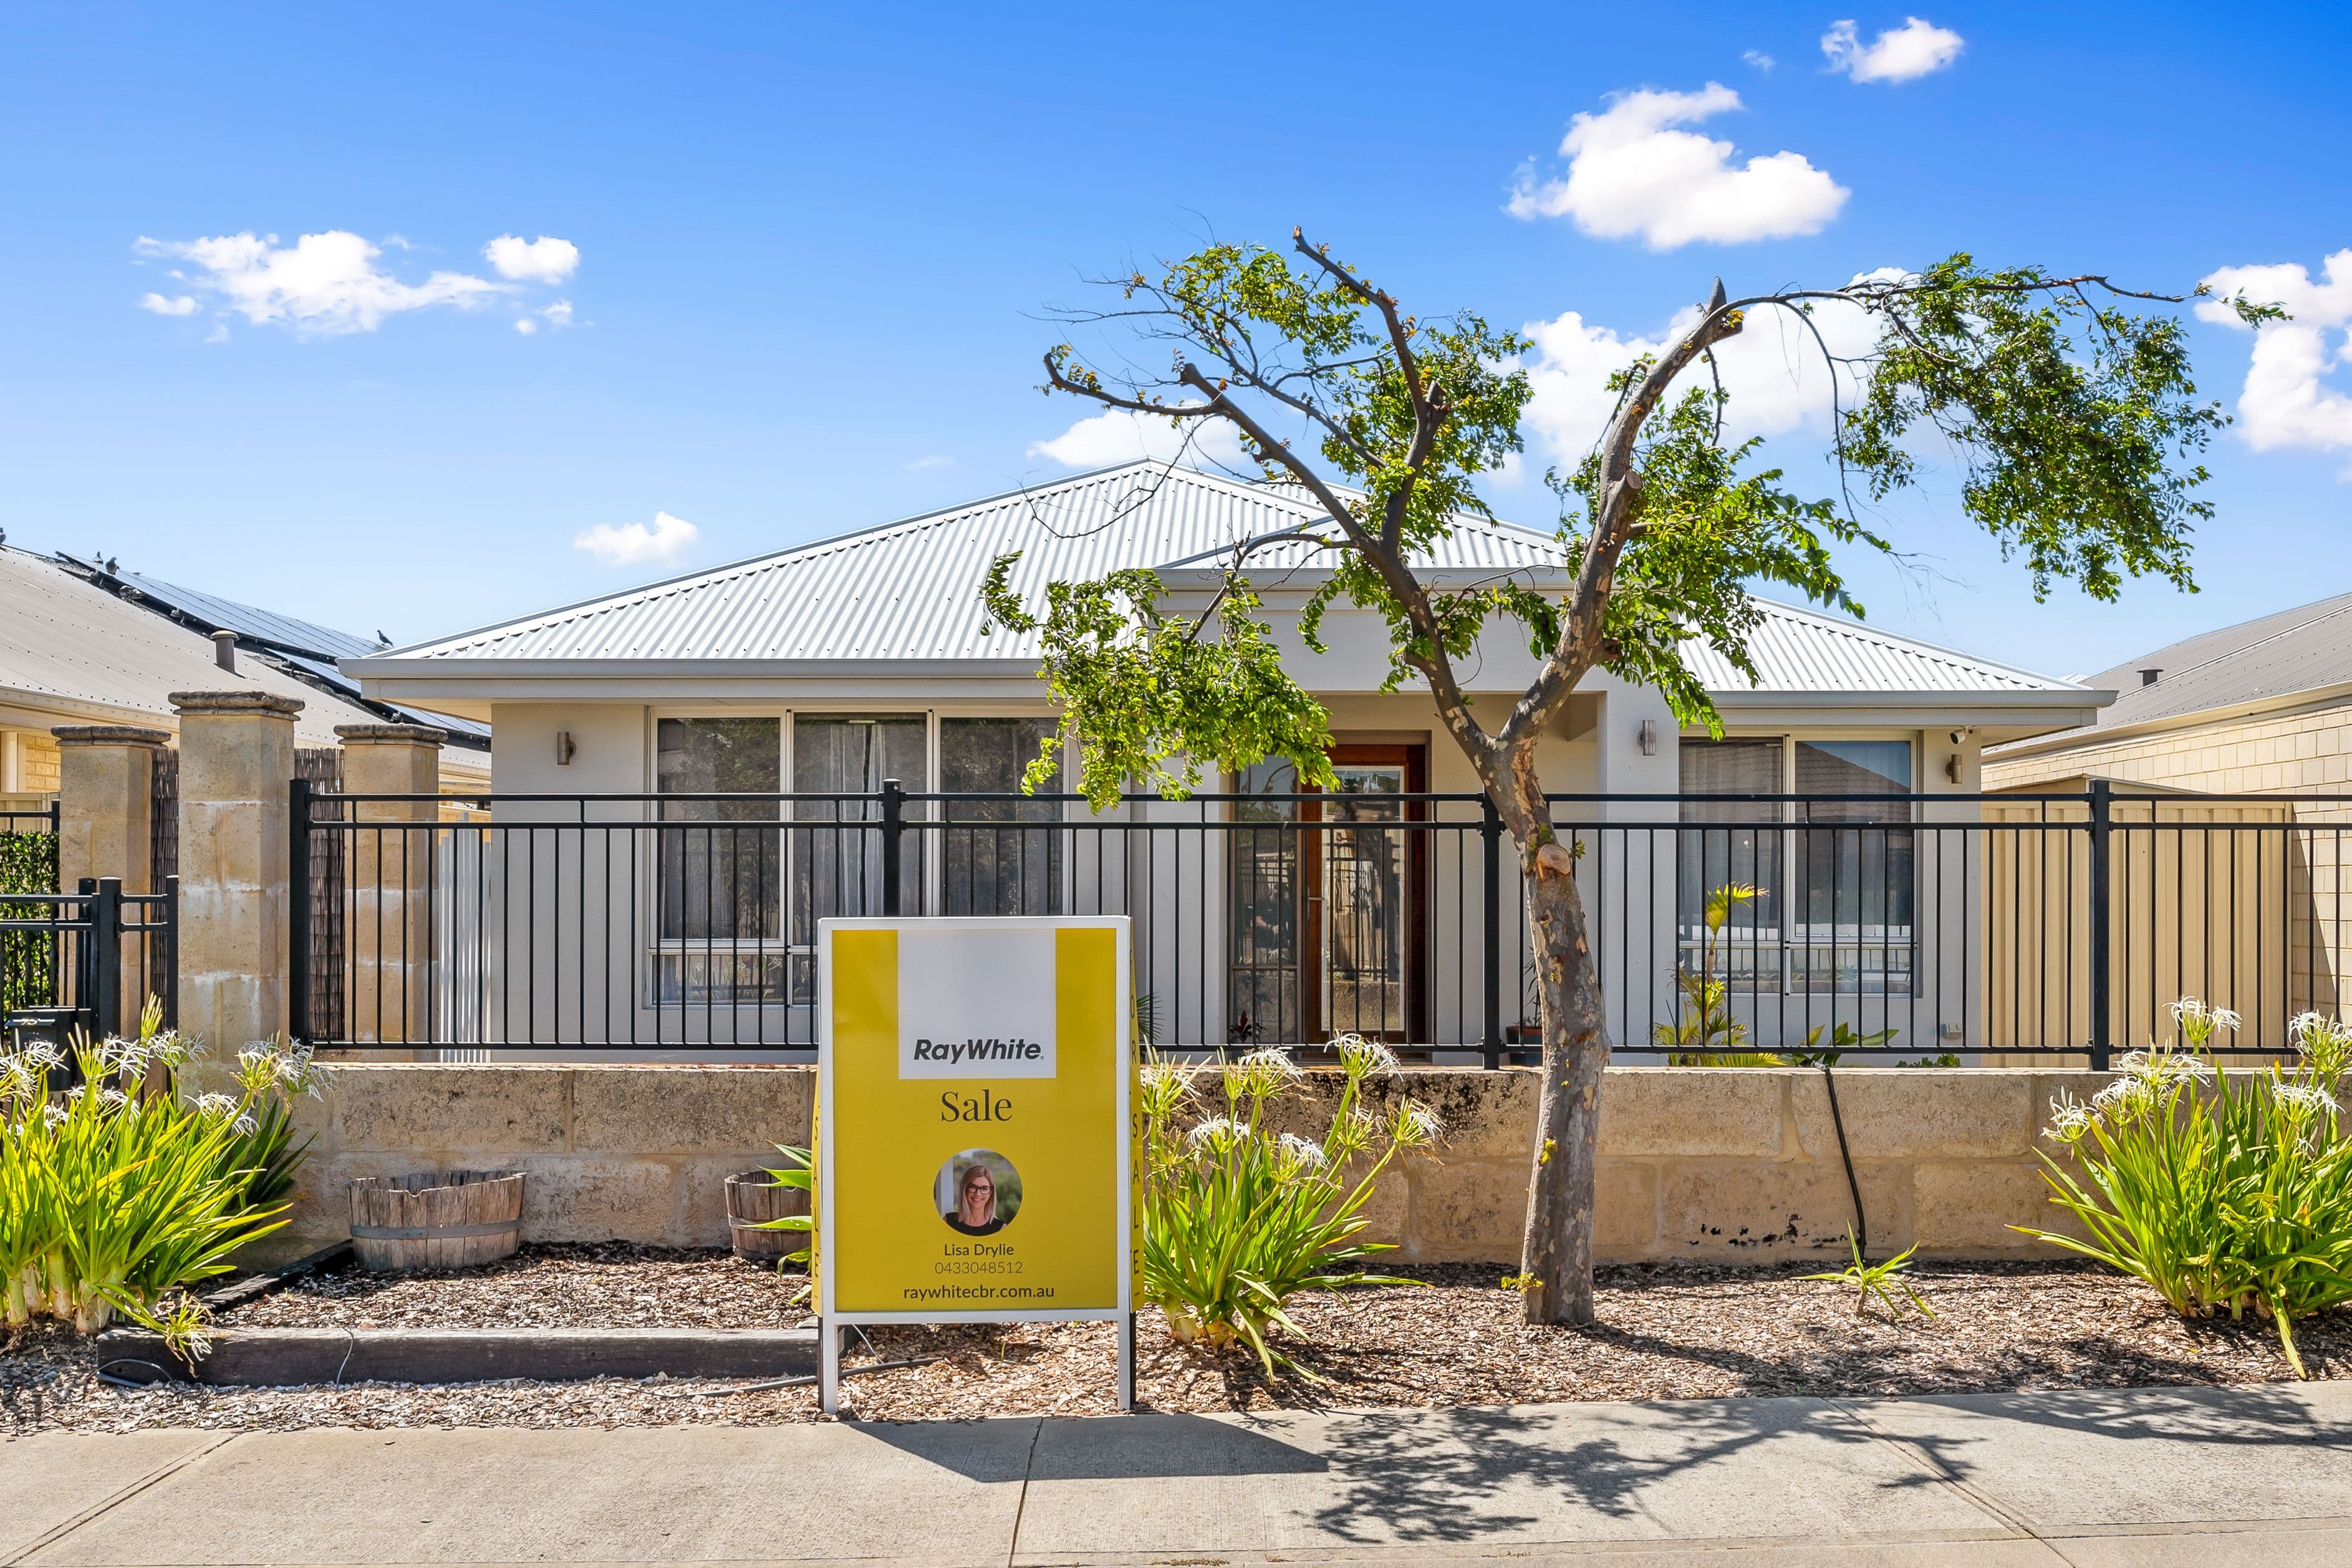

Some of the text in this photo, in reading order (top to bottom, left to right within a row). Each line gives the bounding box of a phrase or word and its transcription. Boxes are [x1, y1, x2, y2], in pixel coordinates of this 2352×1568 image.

[941, 1089, 1013, 1122] Sale
[1131, 1113, 1140, 1276] SALE
[944, 1243, 1015, 1258] Lisa Drylie
[935, 1261, 1023, 1274] 0433048512
[904, 1284, 1054, 1301] raywhitecbr.com.au
